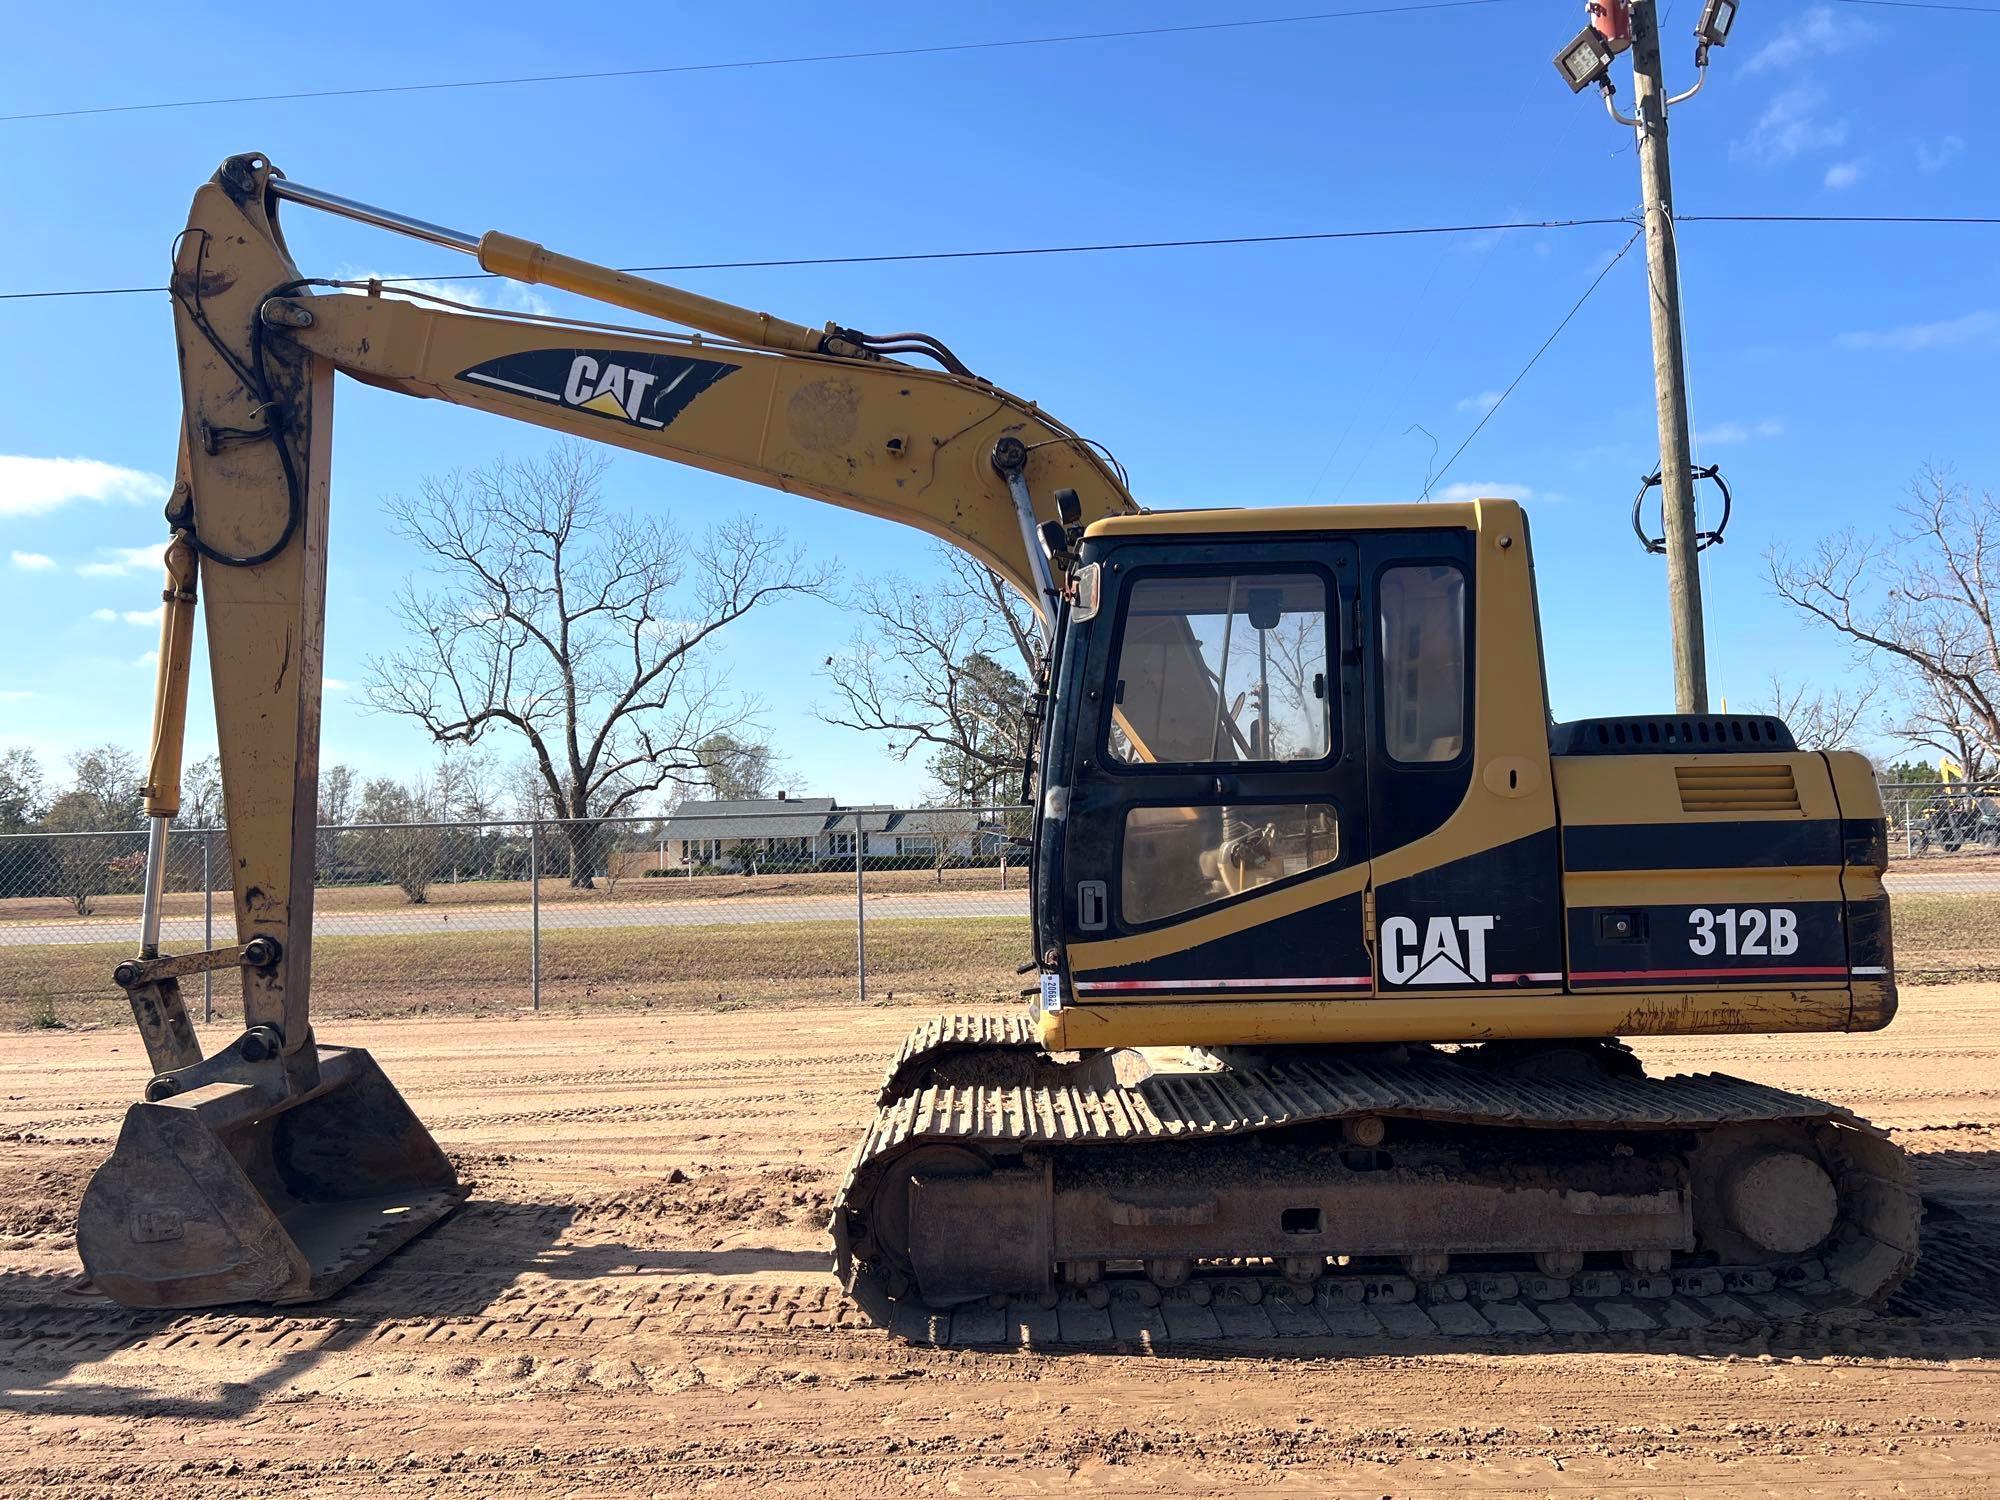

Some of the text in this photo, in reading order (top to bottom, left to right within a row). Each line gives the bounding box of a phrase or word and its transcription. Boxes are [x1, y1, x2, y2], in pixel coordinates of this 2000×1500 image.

[564, 355, 655, 421] CAT
[1380, 915, 1494, 985] CAT
[1688, 908, 1799, 956] 312B
[1047, 982, 1057, 1007] 206825
